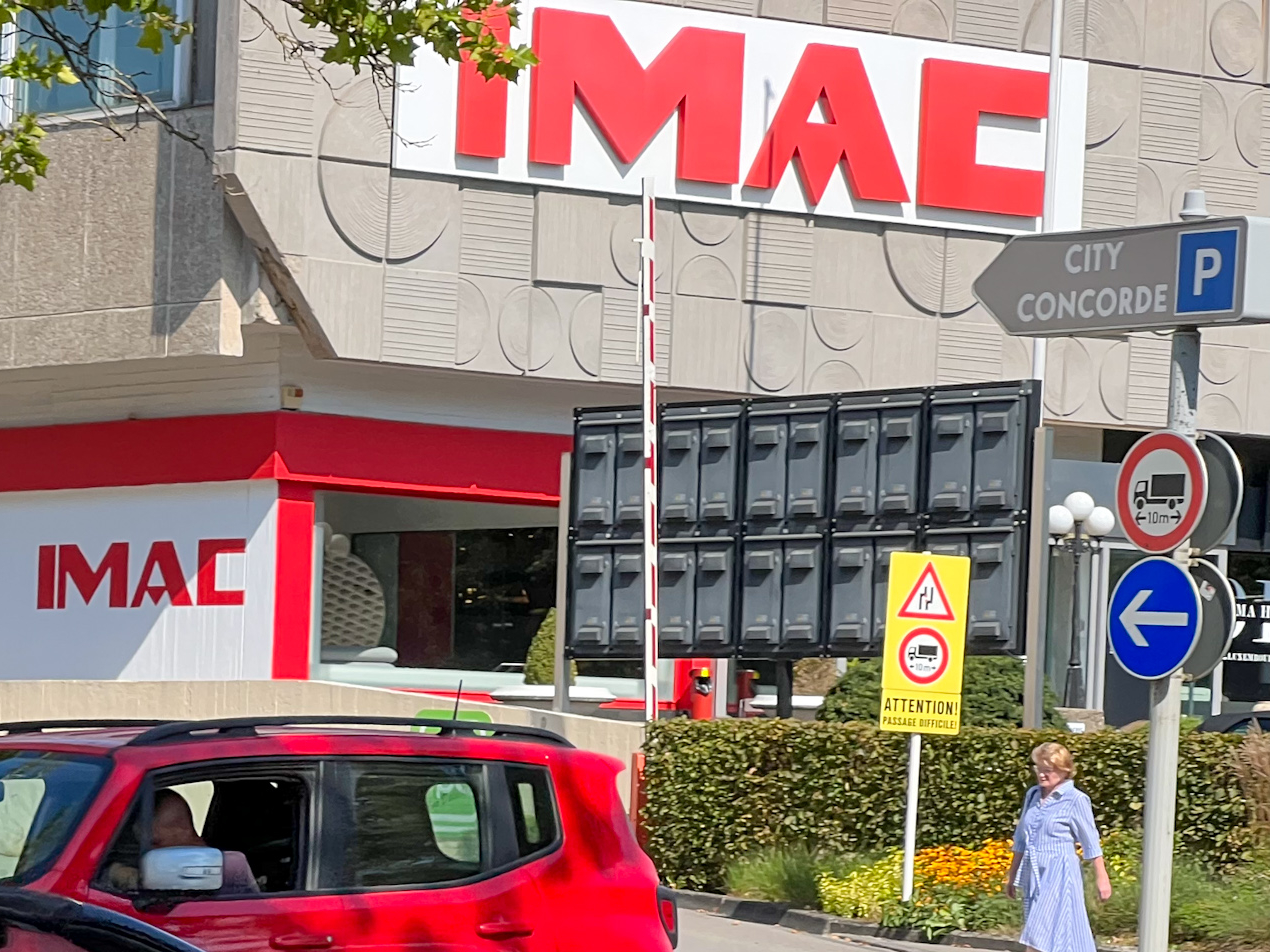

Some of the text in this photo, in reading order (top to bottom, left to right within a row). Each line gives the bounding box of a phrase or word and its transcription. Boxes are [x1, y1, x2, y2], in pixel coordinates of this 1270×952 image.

[456, 0, 1049, 217] IMAC
[1064, 241, 1124, 274] CITY
[1193, 248, 1223, 296] P
[1017, 284, 1168, 322] CONCORDE
[37, 538, 247, 609] IMAC
[883, 716, 957, 730] PASSAGE DIFFICILE!
[884, 698, 958, 716] ATTENTION!
